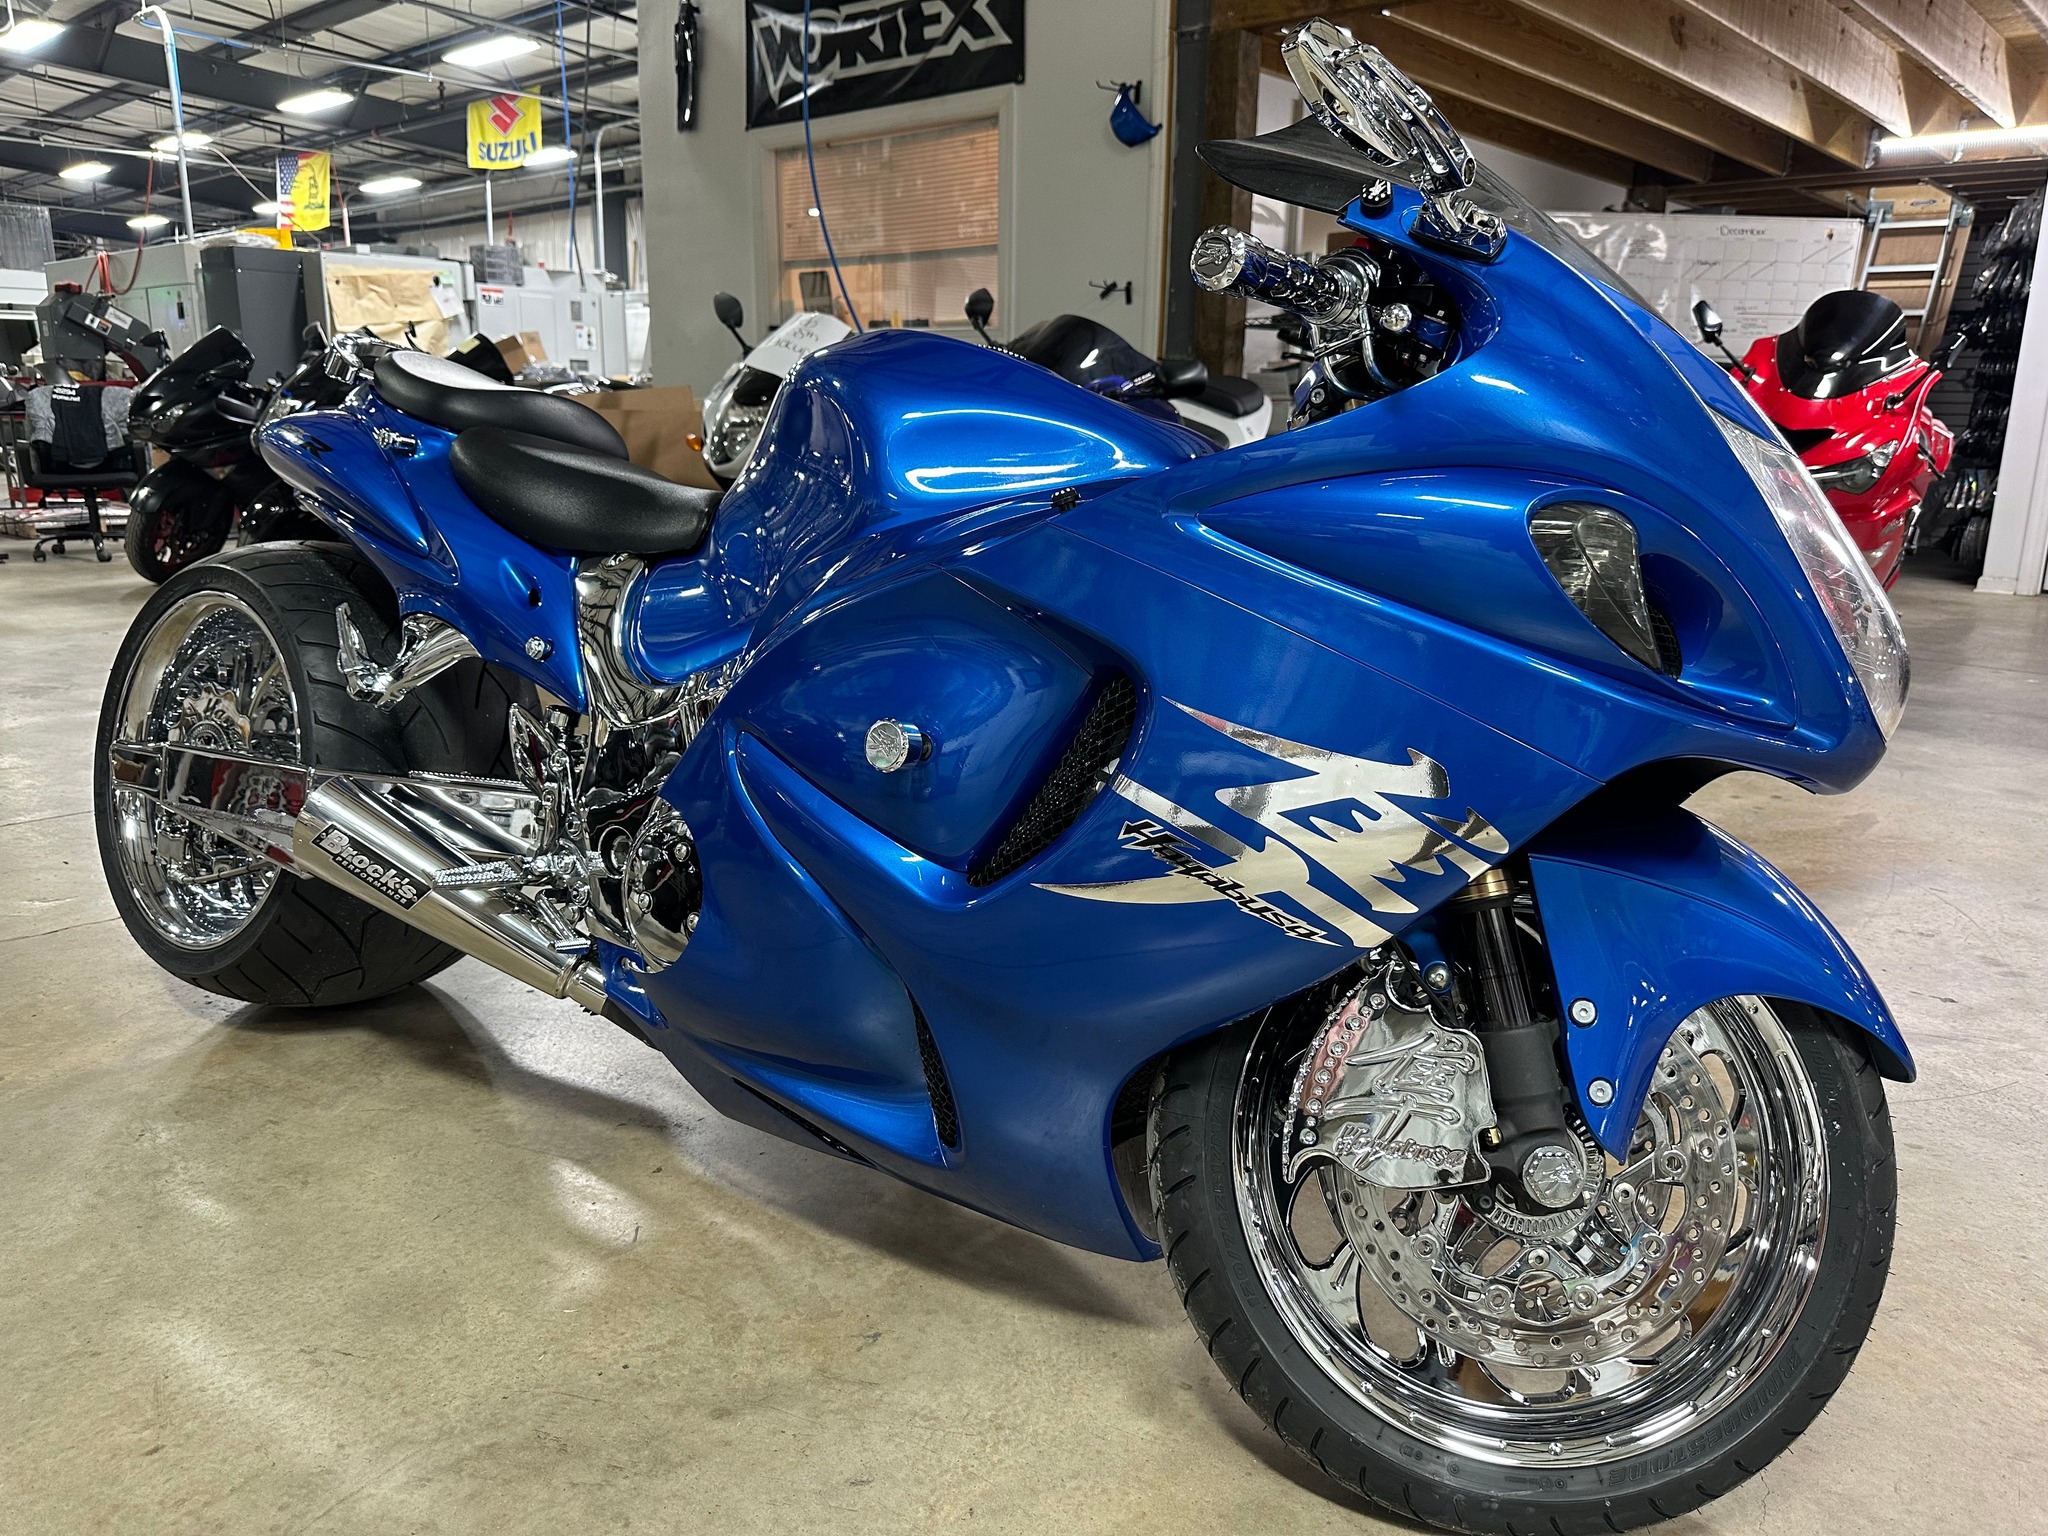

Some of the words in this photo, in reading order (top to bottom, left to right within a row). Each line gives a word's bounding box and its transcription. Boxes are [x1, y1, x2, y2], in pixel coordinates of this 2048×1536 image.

[752, 0, 1013, 105] VORTEX
[319, 829, 417, 899] Brock's
[335, 856, 408, 904] PERFORMANCE
[1117, 819, 1344, 947] Hayabusa
